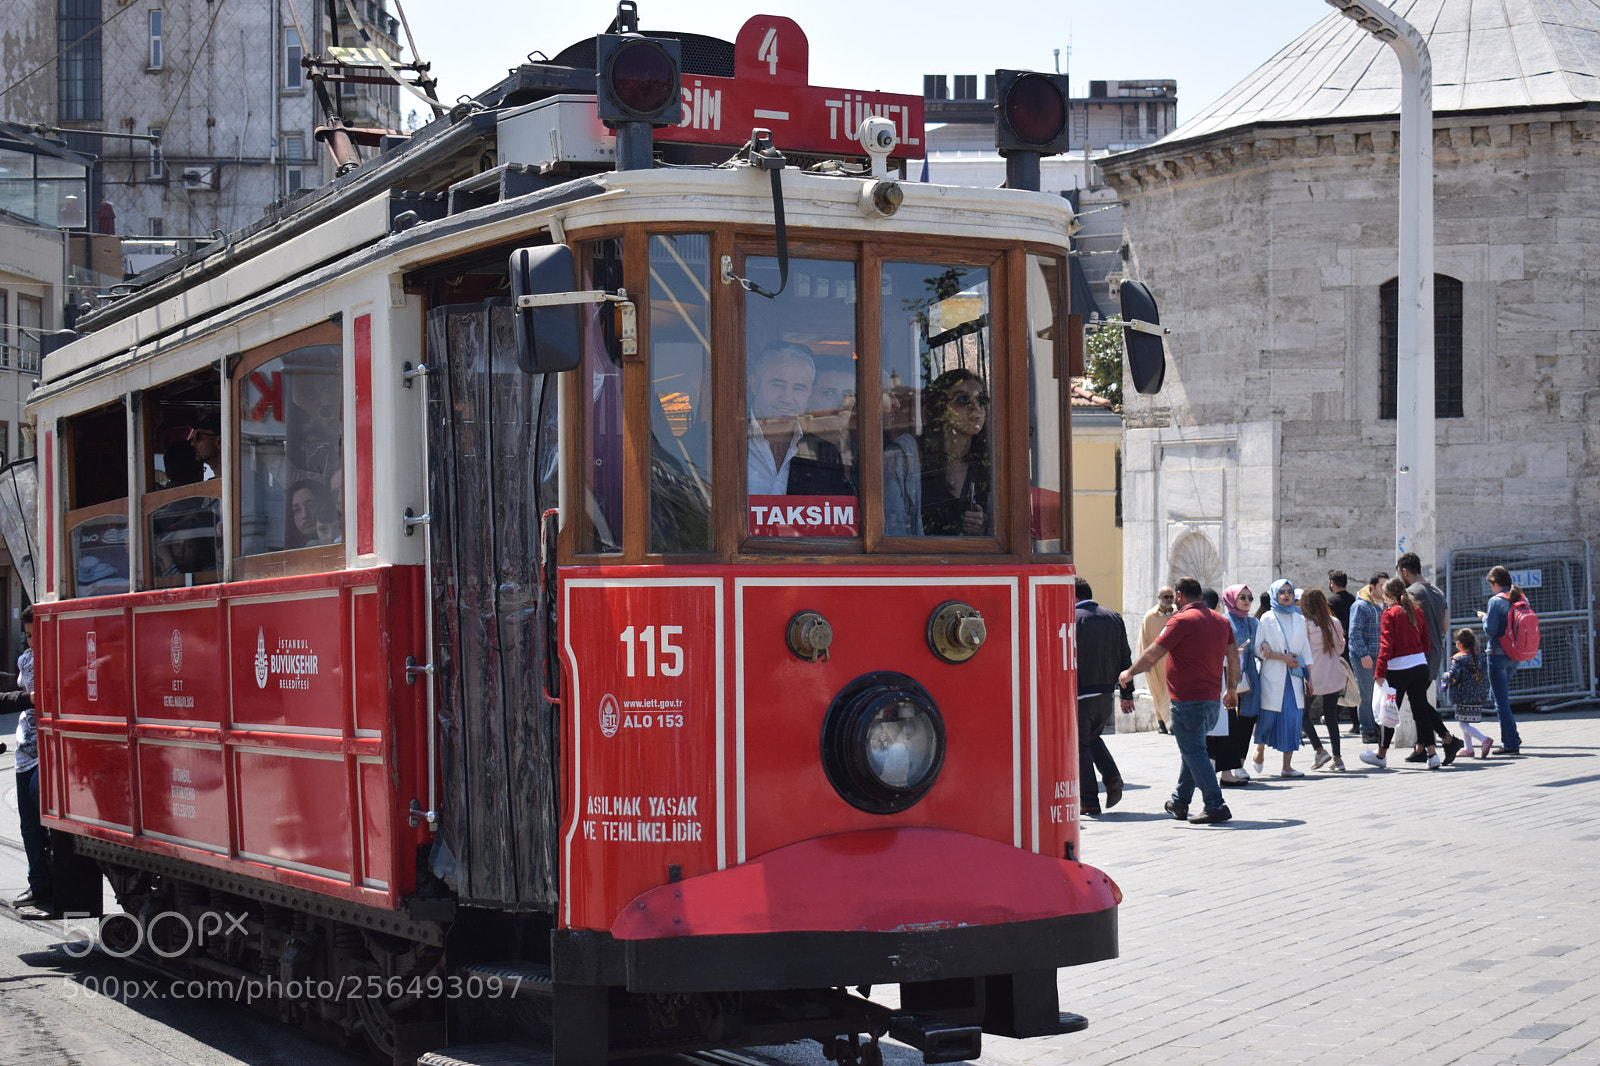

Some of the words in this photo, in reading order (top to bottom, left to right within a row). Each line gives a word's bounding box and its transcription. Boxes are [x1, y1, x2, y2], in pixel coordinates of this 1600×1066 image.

[758, 27, 778, 75] 4
[676, 79, 721, 130] SİM
[750, 501, 854, 525] TAKSİM
[278, 636, 308, 649] İSTANBUL
[620, 625, 684, 677] 115
[270, 648, 318, 680] BÜYÜKŞEHİR
[623, 699, 683, 709] www.iett.gov.tr
[623, 714, 653, 728] ALO
[656, 714, 684, 728] 153
[648, 796, 697, 817] YASAK
[1050, 804, 1063, 824] VE
[583, 820, 596, 840] VE
[602, 819, 702, 842] TEHLİKELİDİR
